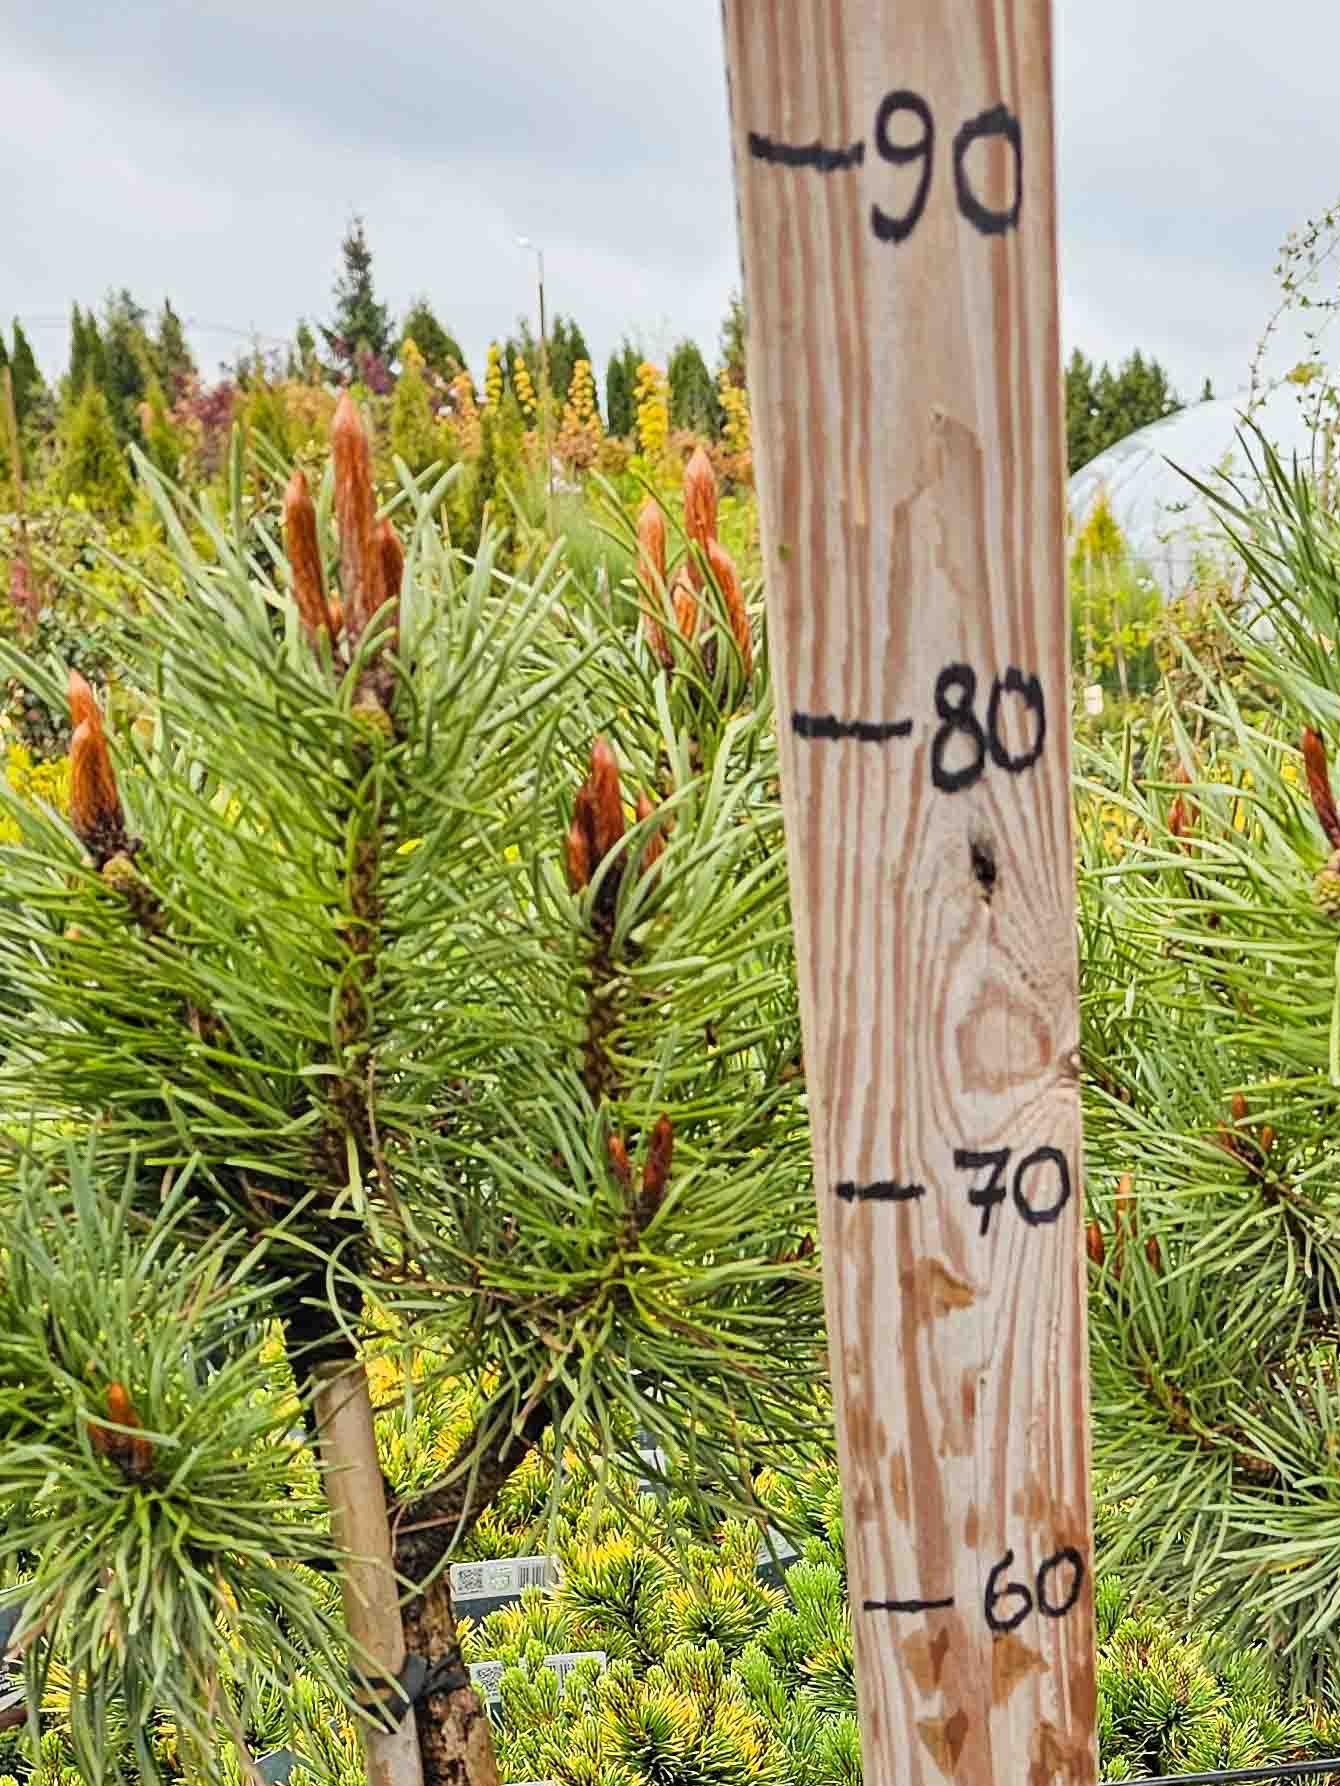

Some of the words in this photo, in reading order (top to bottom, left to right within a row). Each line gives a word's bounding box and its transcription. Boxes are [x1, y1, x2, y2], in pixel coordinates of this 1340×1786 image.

[872, 91, 1023, 244] 90
[931, 662, 1046, 794] 80
[954, 1146, 1071, 1236] 70
[984, 1543, 1086, 1635] 60
